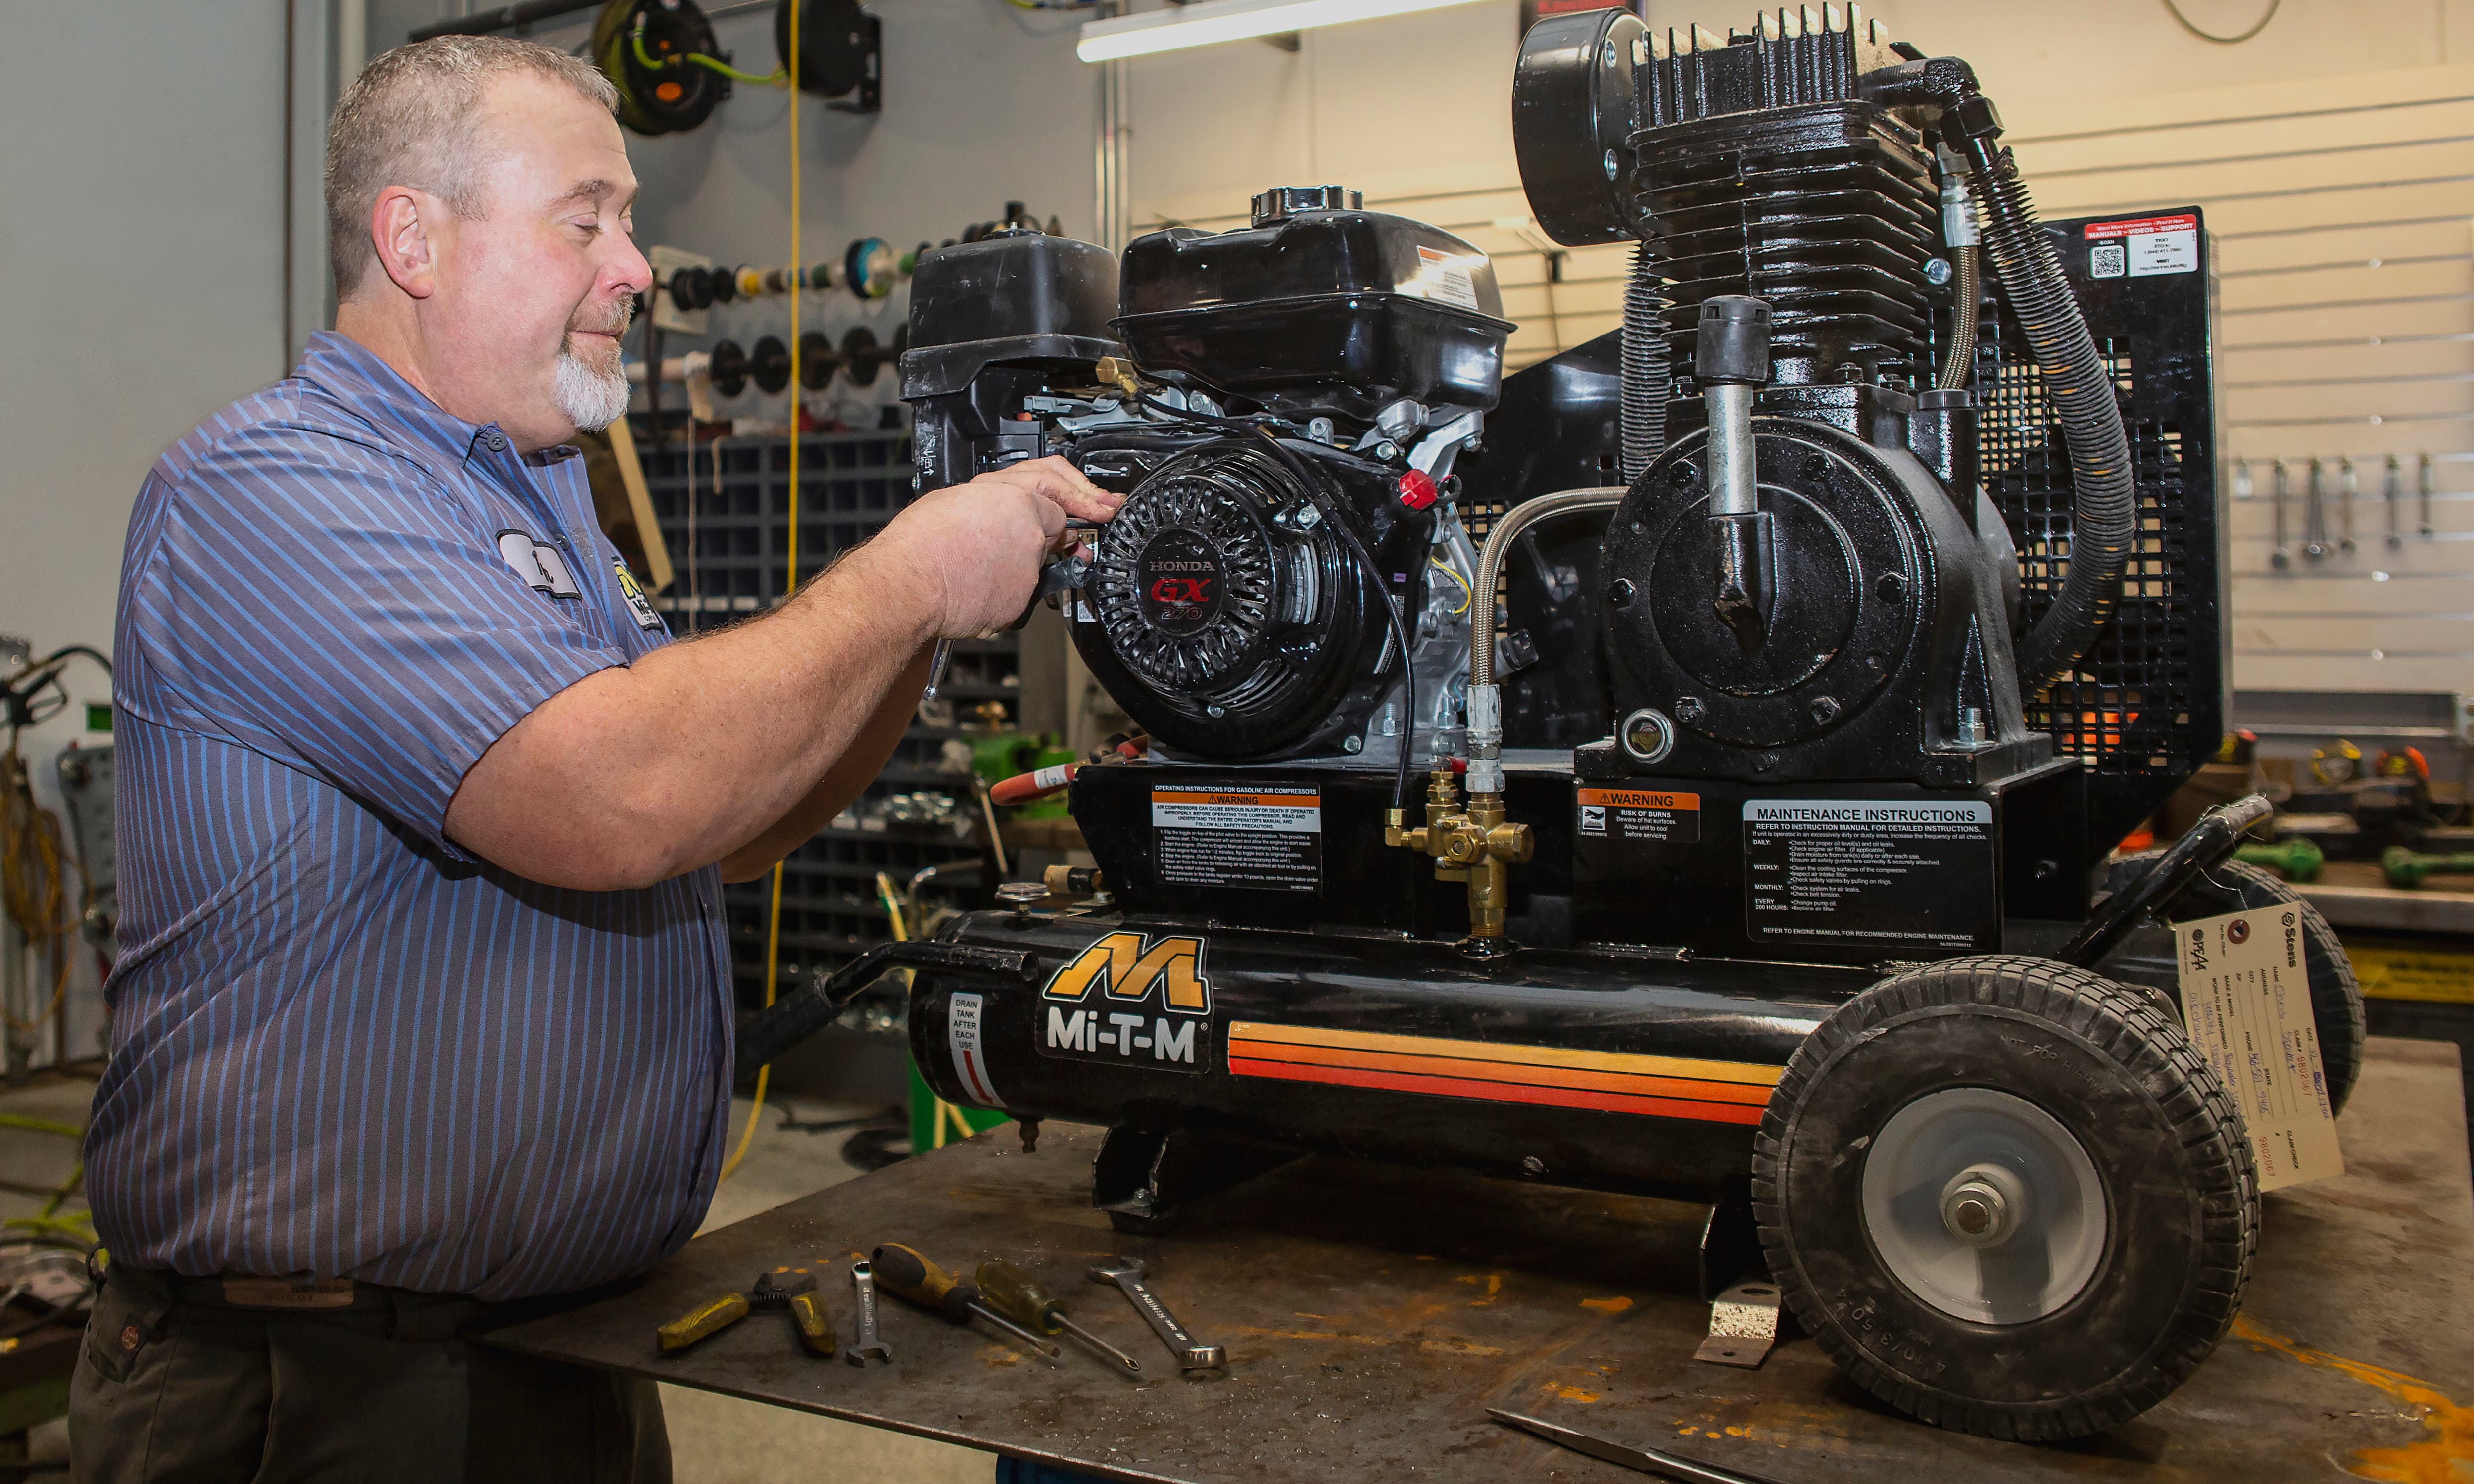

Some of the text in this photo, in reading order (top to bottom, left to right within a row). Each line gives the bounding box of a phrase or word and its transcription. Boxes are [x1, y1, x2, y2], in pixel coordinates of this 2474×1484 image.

[1150, 561, 1216, 571] HONDA
[1151, 578, 1212, 602] GX
[1161, 607, 1203, 620] 270
[1154, 784, 1184, 793] OPERATING
[1185, 785, 1223, 794] INSTRUCTIONS
[1216, 795, 1258, 805] WARNING
[1611, 793, 1673, 806] WARNING
[1757, 808, 1975, 822] MAINTENANCE INSTRUCTIONS
[2285, 928, 2297, 968] Stens
[956, 999, 978, 1009] DRAIN
[956, 1010, 975, 1018] TANK
[953, 1020, 976, 1029] AFTER
[2217, 1013, 2228, 1049] PERFORMED
[955, 1030, 975, 1039] EACH
[1048, 1005, 1196, 1064] Mi-T-M
[2032, 1044, 2059, 1064] FOR
[2258, 1136, 2275, 1178] 9802067
